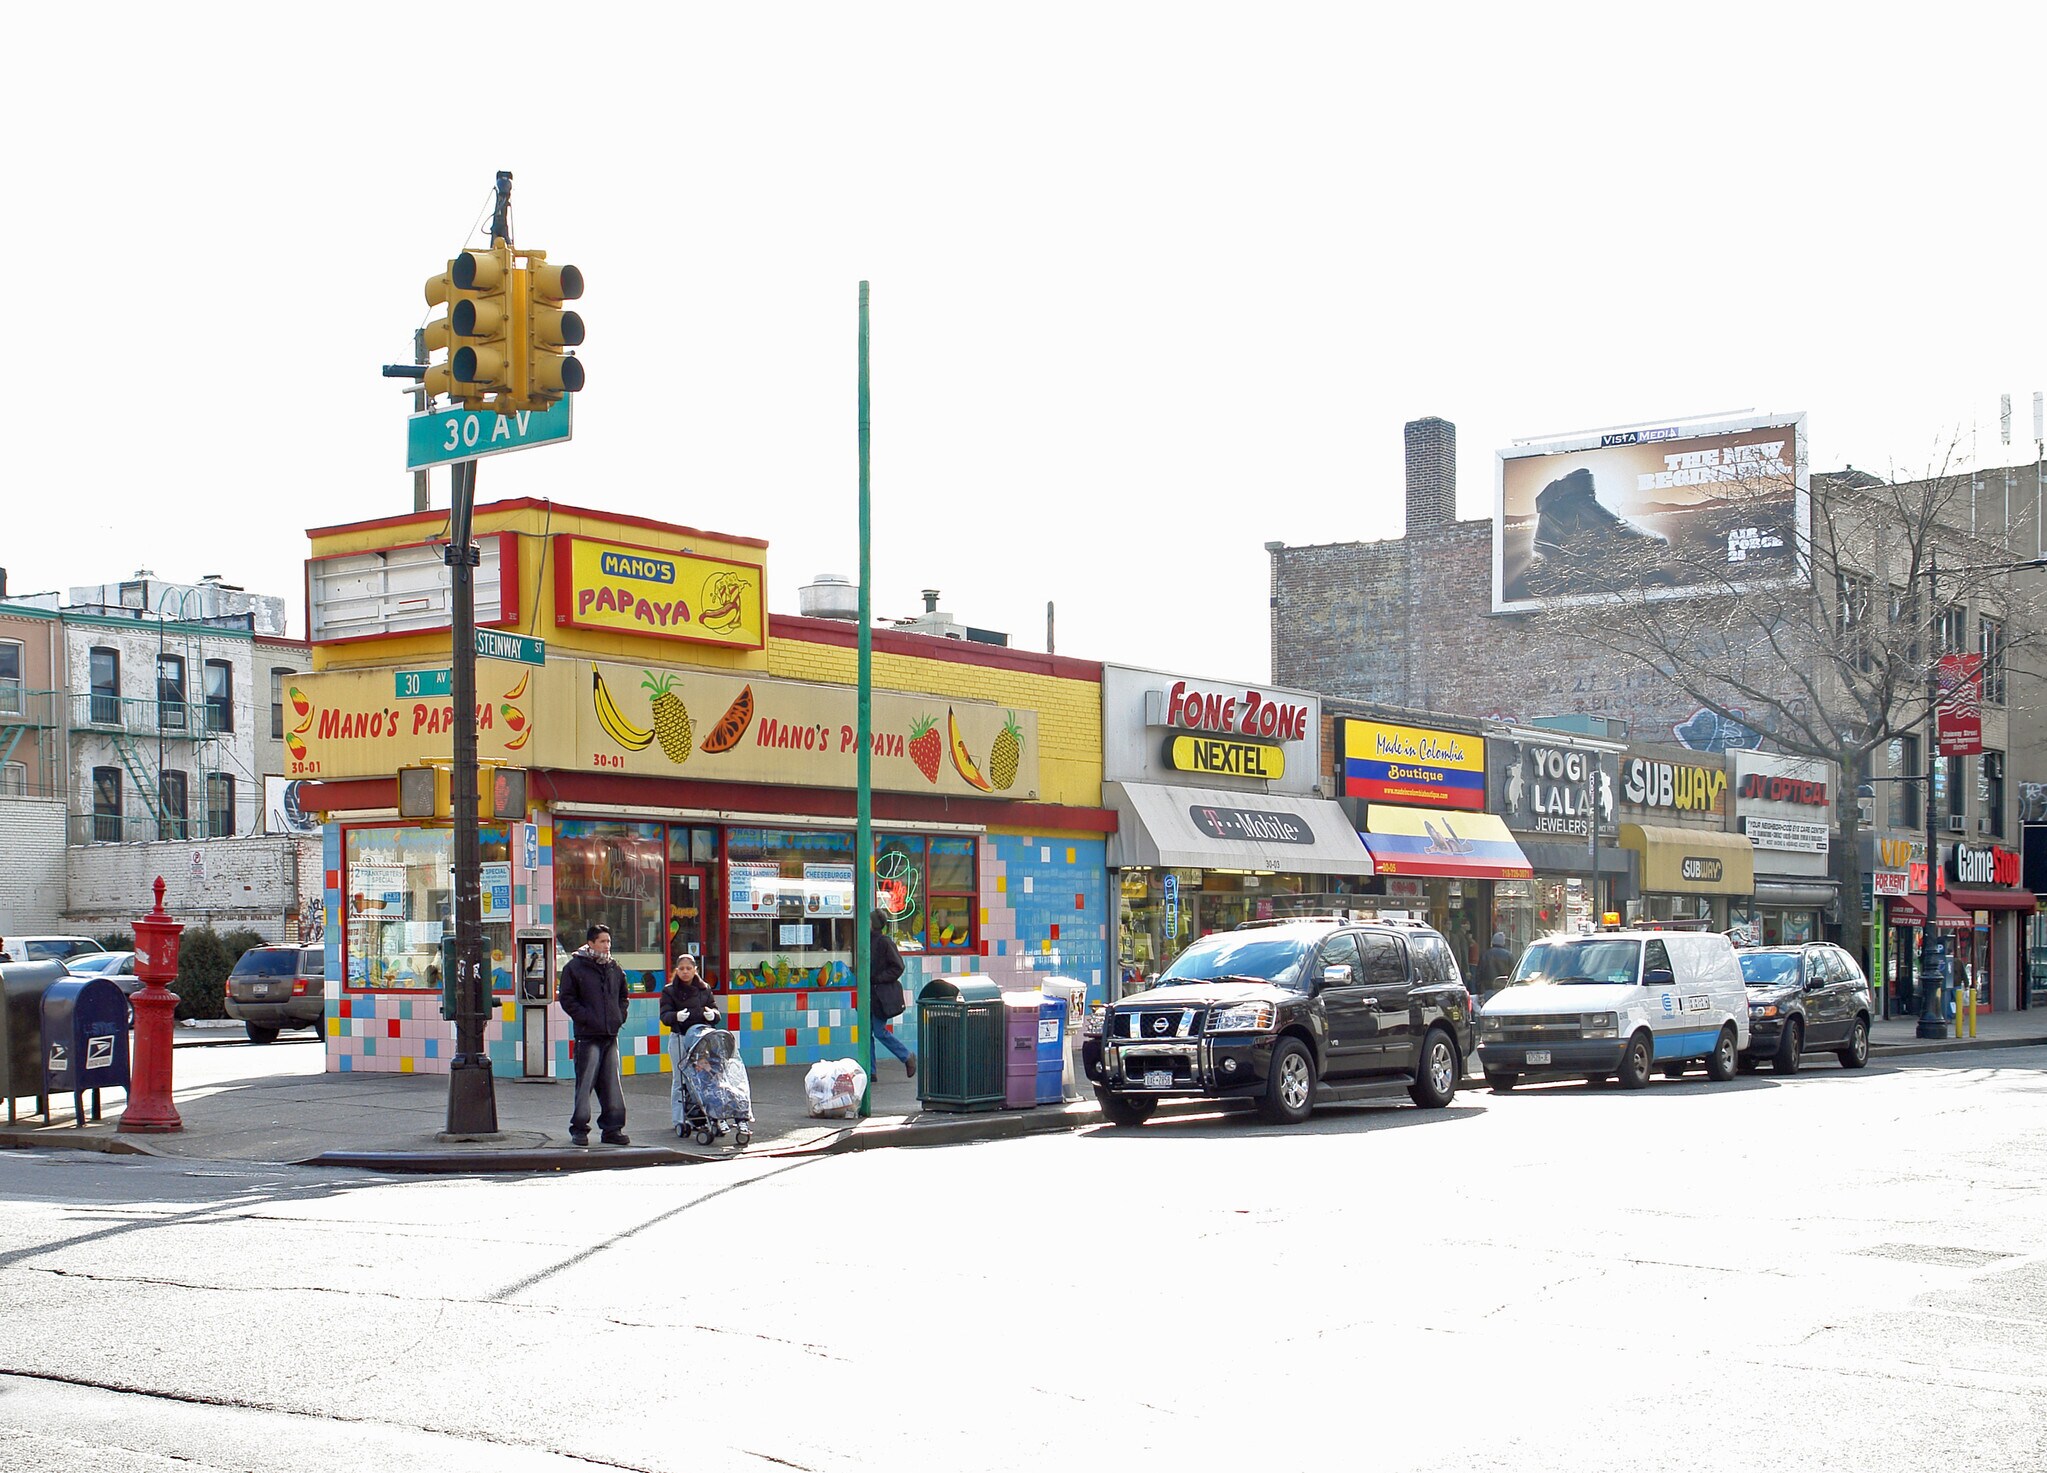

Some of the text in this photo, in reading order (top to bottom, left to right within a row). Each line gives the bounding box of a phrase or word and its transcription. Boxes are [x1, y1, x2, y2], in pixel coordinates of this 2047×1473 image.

[443, 411, 530, 451] 30 AV
[1603, 428, 1677, 445] VISTA MEDIA
[1664, 449, 1719, 470] THE
[605, 556, 672, 580] MANO'S
[578, 586, 691, 627] PAPAYA
[478, 632, 543, 659] STEINWAY ST
[405, 672, 446, 695] 30 AV
[1167, 681, 1308, 741] FONE ZONE
[1194, 740, 1267, 775] NEXTEL
[1376, 732, 1402, 755] Made
[1419, 738, 1464, 762] Colombia
[291, 761, 320, 774] 30-01
[593, 753, 625, 769] 30-01
[1531, 748, 1587, 781] YOGI
[1388, 765, 1444, 783] Boutique
[1625, 758, 1727, 811] SUBWAY
[1531, 784, 1590, 816] LALA
[1745, 774, 1830, 807] JV OPTICAL
[1535, 817, 1588, 834] JEWELERS
[1266, 860, 1280, 869] 30-03
[1881, 838, 1911, 867] VIP
[355, 869, 360, 877] 2
[806, 871, 851, 879] CHEESEBURGER
[1682, 860, 1720, 879] SUBWAY
[1958, 843, 2020, 887] GameStop
[1876, 873, 1905, 891] FOR RENT
